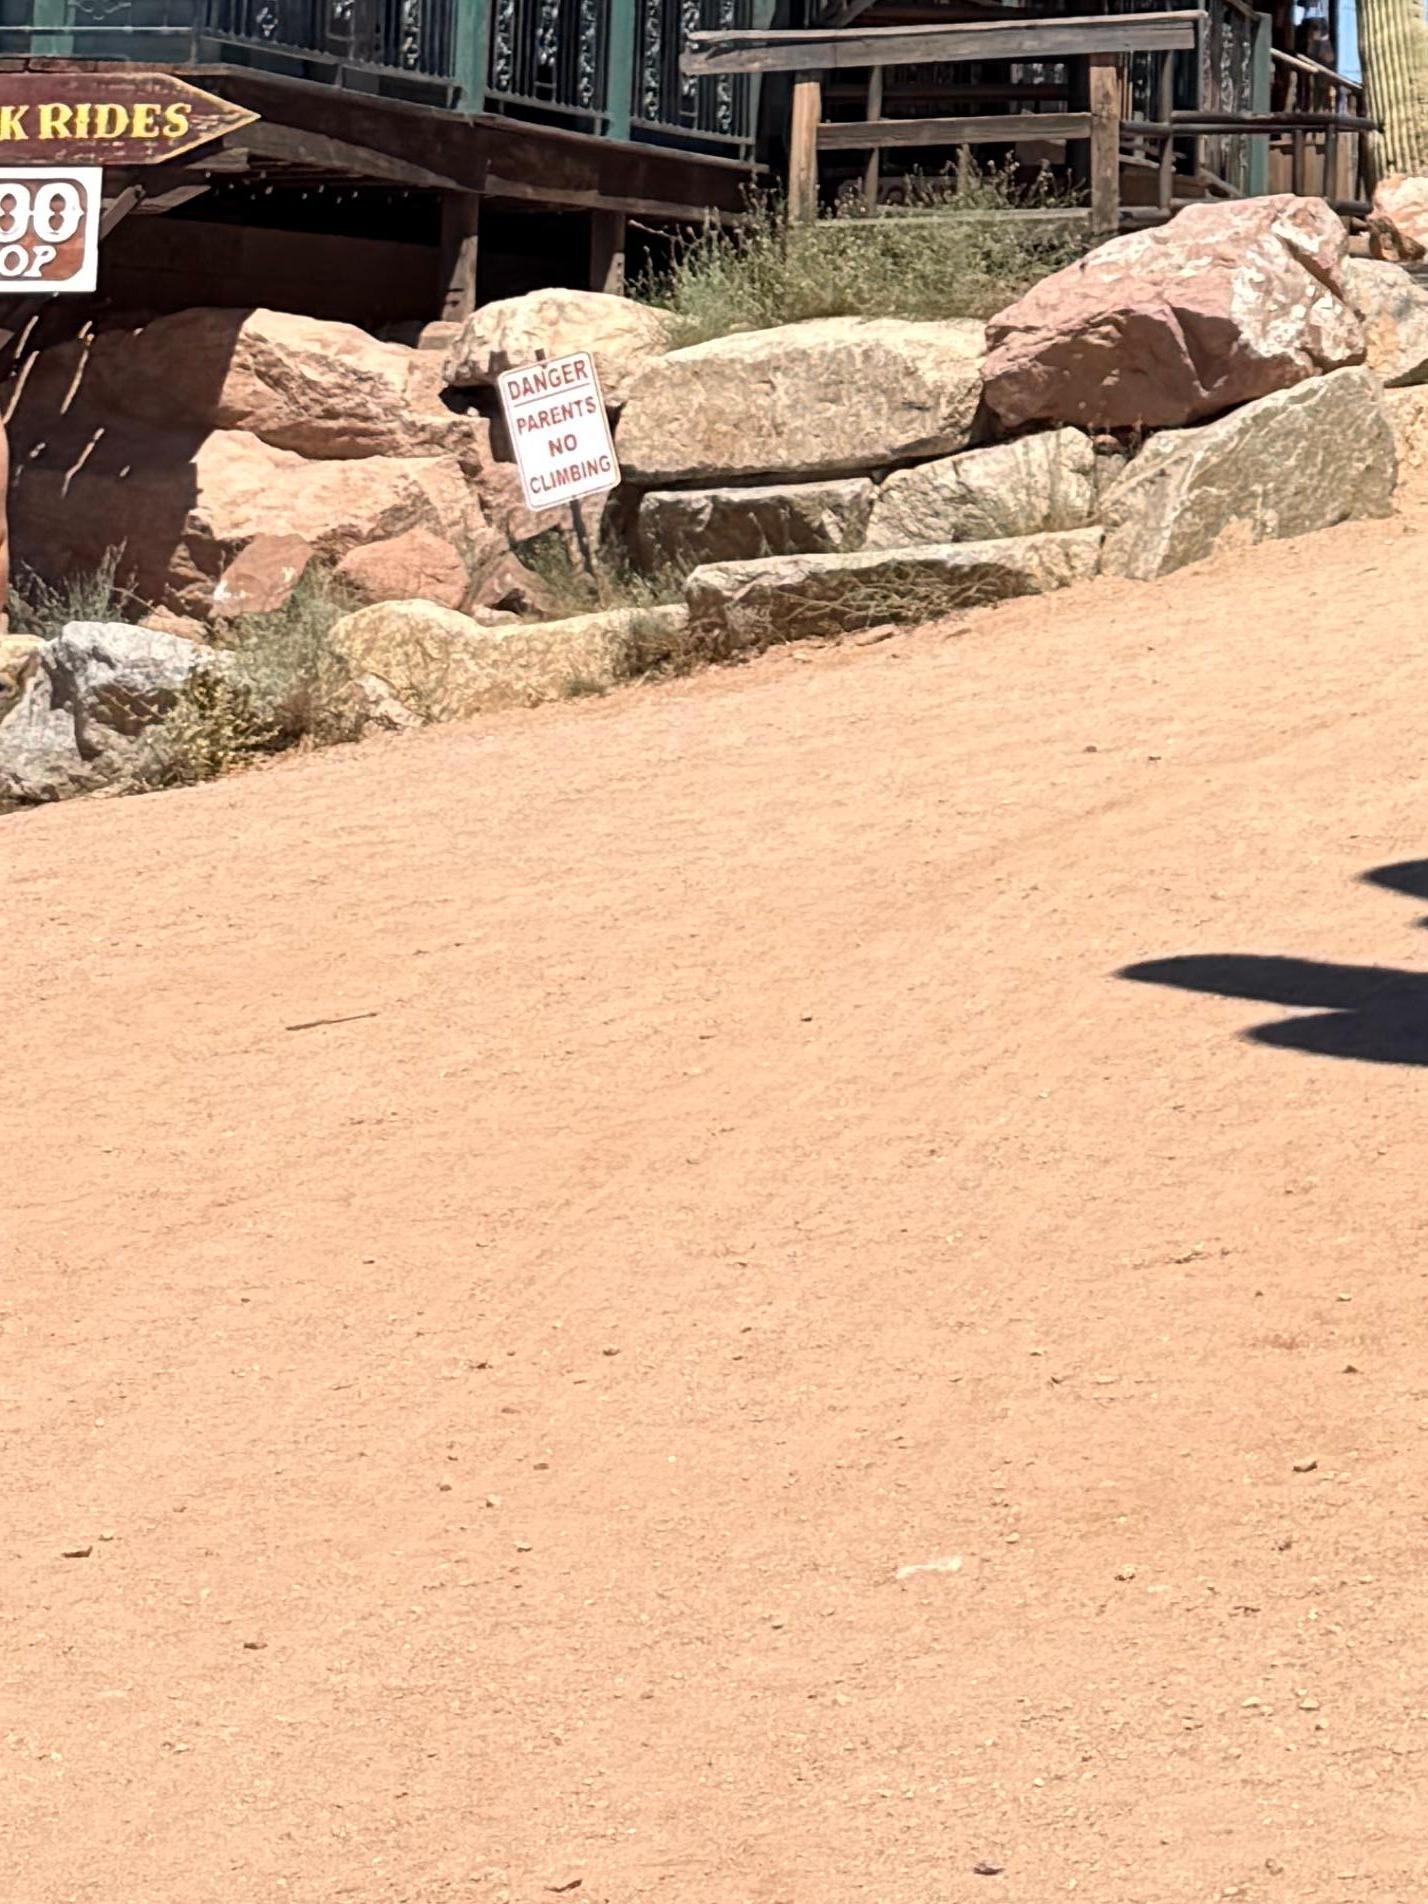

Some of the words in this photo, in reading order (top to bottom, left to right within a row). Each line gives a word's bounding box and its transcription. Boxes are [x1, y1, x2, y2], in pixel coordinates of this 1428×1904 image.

[38, 102, 192, 140] RIDES
[507, 359, 589, 401] DANGER
[516, 395, 597, 435] PARENTS
[547, 433, 578, 457] NO
[529, 454, 611, 494] CLIMBING
